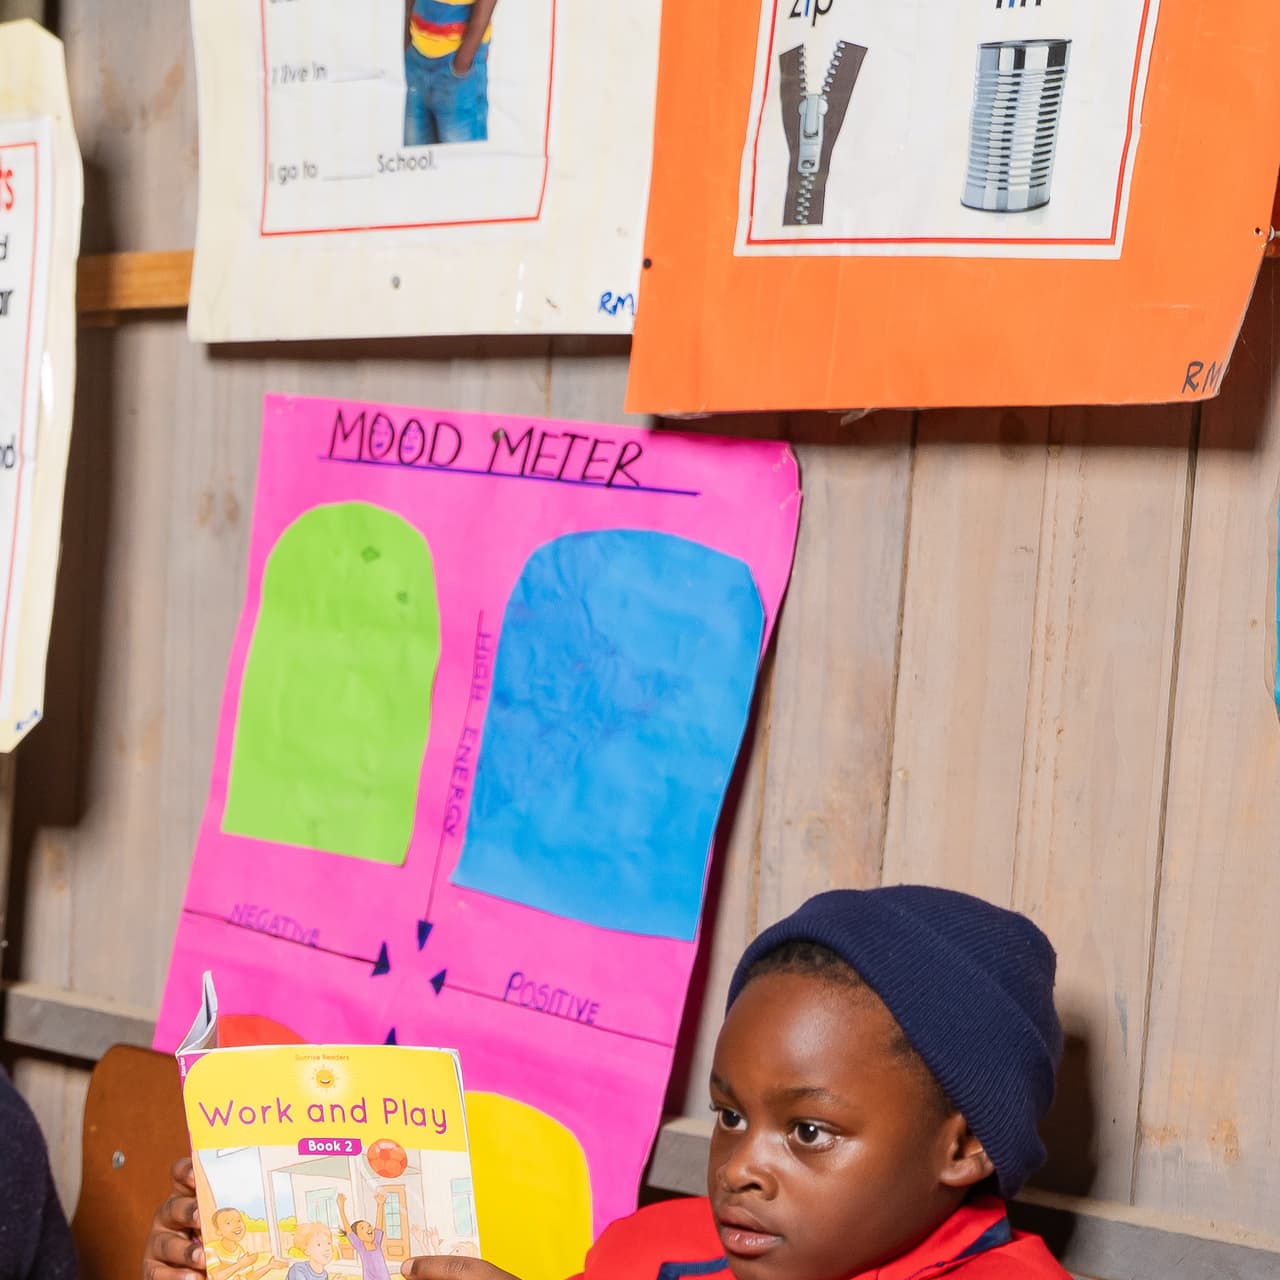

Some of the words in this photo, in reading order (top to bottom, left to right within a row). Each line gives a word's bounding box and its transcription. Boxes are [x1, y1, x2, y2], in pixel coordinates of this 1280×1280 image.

[281, 64, 309, 84] live
[312, 61, 328, 81] in
[278, 165, 298, 187] go
[303, 160, 318, 180] to
[377, 151, 438, 174] School.
[597, 289, 636, 318] RM
[1181, 360, 1225, 396] RM
[328, 406, 463, 469] MOOD
[487, 425, 644, 489] METER
[471, 631, 492, 702] HIGH
[443, 726, 479, 838] ENERGY
[502, 971, 601, 1026] POSITIVE
[198, 1096, 294, 1128] Work
[306, 1096, 368, 1124] and
[382, 1097, 448, 1135] Play
[308, 1139, 342, 1153] Book
[345, 1140, 354, 1153] 2
